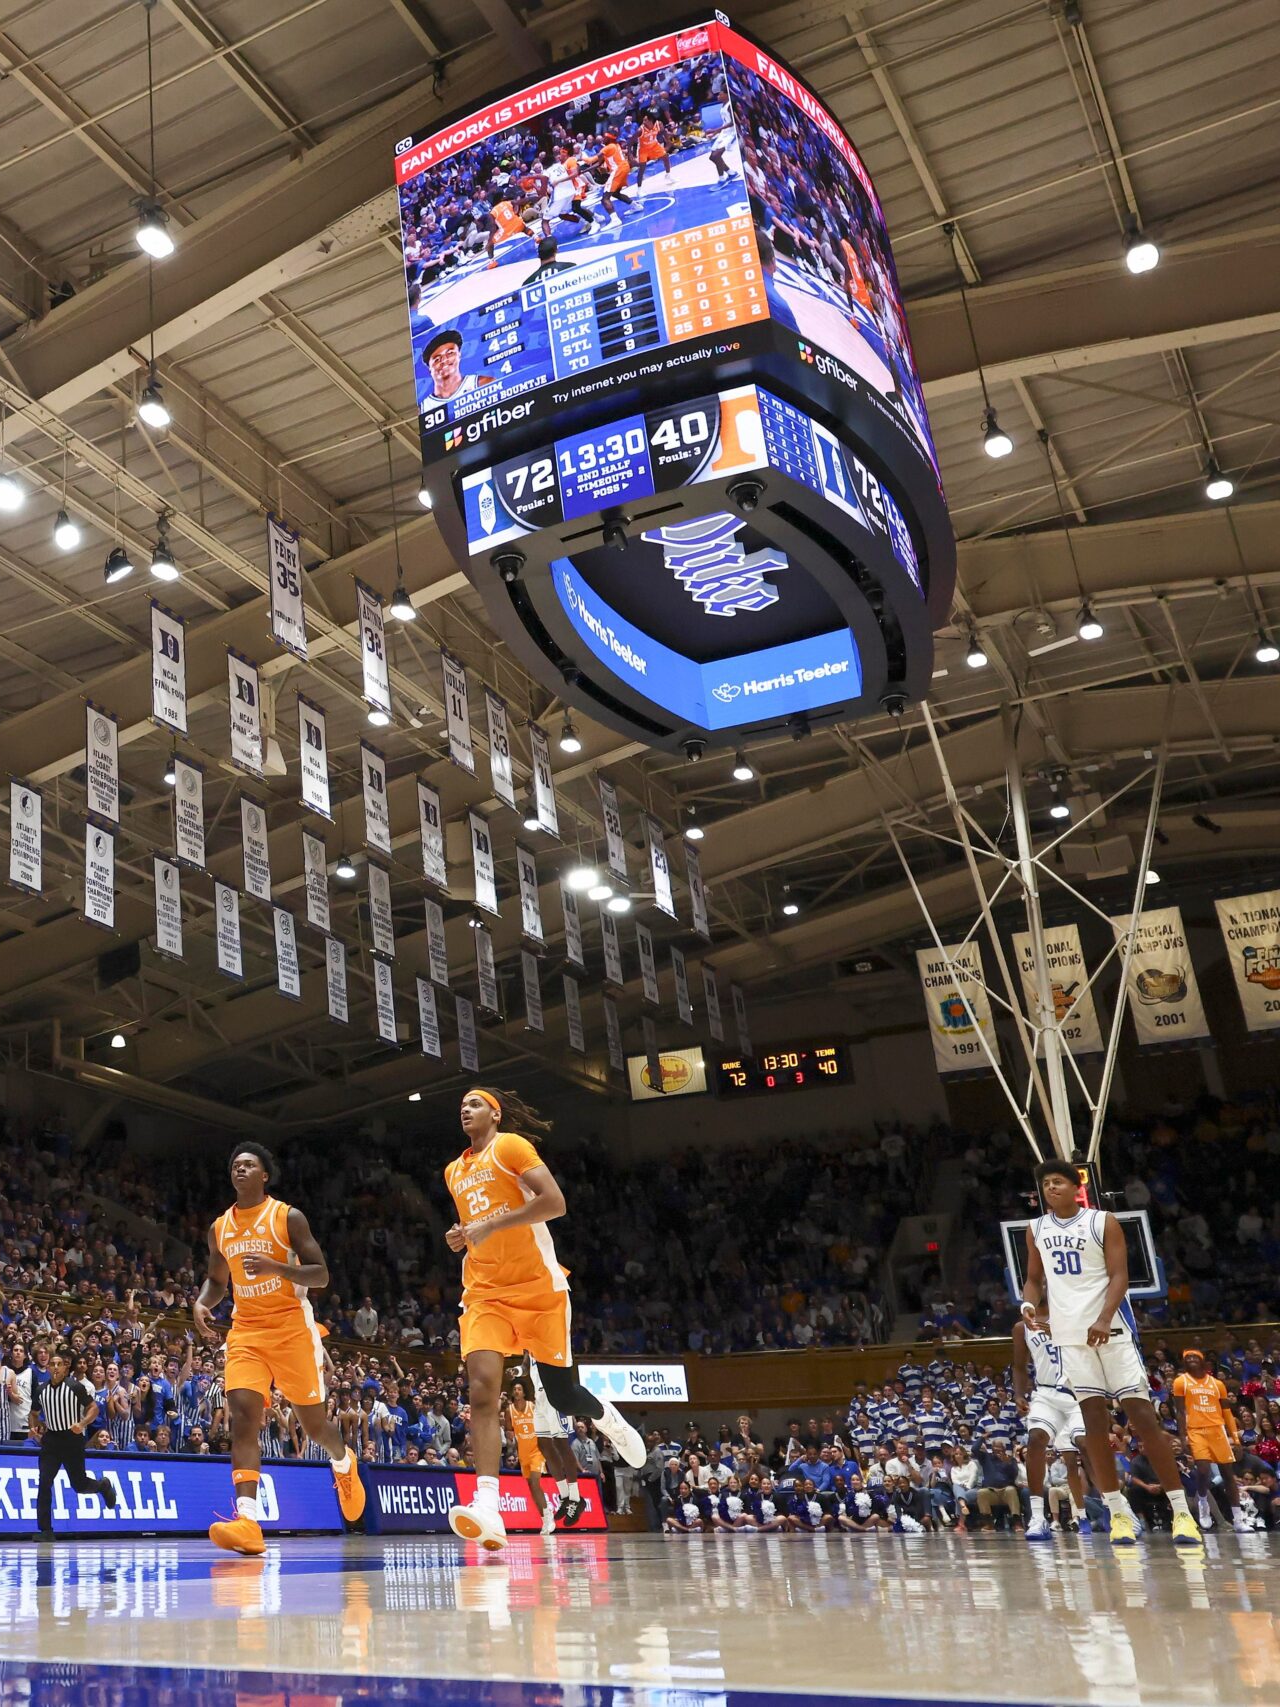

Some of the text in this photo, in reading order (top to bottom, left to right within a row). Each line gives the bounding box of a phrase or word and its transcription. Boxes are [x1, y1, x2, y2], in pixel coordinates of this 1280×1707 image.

[717, 13, 729, 25] CC
[401, 46, 670, 175] FAN WORK IS THIRSTY WORK
[757, 52, 845, 149] FAN WORK
[397, 139, 411, 153] CC
[660, 218, 750, 251] PL PTS REB FLS
[671, 253, 752, 282] 2 7 0 2
[485, 297, 512, 313] POINTS
[551, 280, 626, 315] O-REB 3
[552, 292, 632, 330] D-REB 12
[495, 310, 505, 323] 8
[560, 308, 630, 342] BLK 0
[674, 304, 761, 335] 25 2 3 2
[485, 321, 519, 340] FIELD GOALS
[489, 331, 518, 352] 4-6
[563, 324, 632, 356] STL 3
[488, 345, 522, 364] REBOUNDS
[501, 361, 512, 374] 4
[569, 339, 635, 370] TO 9
[553, 341, 740, 403] Try internet you may actually love
[816, 355, 858, 391] gfiber
[454, 382, 502, 409] JOAQUIM
[455, 375, 547, 418] BOUMTJE BOUMTJE
[425, 409, 444, 429] 30
[467, 399, 535, 441] gfiber
[651, 411, 709, 450] 40
[559, 427, 645, 477] 13:30
[659, 447, 701, 465] Fouls: 3
[507, 459, 554, 499] 72
[566, 466, 645, 497] 3 TIMEOUTS 2
[577, 460, 630, 482] 2ND HALF
[593, 484, 620, 499] POSS
[853, 456, 885, 516] 72
[516, 495, 553, 514] Fouls: 0
[276, 561, 299, 597] 35
[365, 627, 383, 661] 32
[577, 595, 646, 675] Harris Teeter
[155, 678, 171, 695] FINAL
[162, 668, 178, 684] NCAA
[744, 660, 849, 695] Harris Teeter
[452, 694, 463, 721] 11
[93, 749, 112, 767] ATLANTIC
[96, 759, 111, 774] COAST
[89, 765, 118, 787] CONFERENCE
[1155, 1013, 1186, 1027] 2001
[722, 1048, 835, 1070] DUKE 13:30 TENN
[952, 1042, 980, 1055] 1991
[729, 1060, 837, 1087] 72 0 3 40
[454, 1168, 495, 1197] TENNESSEE
[467, 1187, 489, 1216] 25
[225, 1240, 273, 1260] TENNESSEE
[1044, 1236, 1086, 1251] DUKE
[1052, 1251, 1082, 1275] 30
[630, 1371, 664, 1383] North
[631, 1383, 682, 1396] Carolina
[1200, 1396, 1208, 1405] 12
[378, 1485, 455, 1514] WHEELS UP
